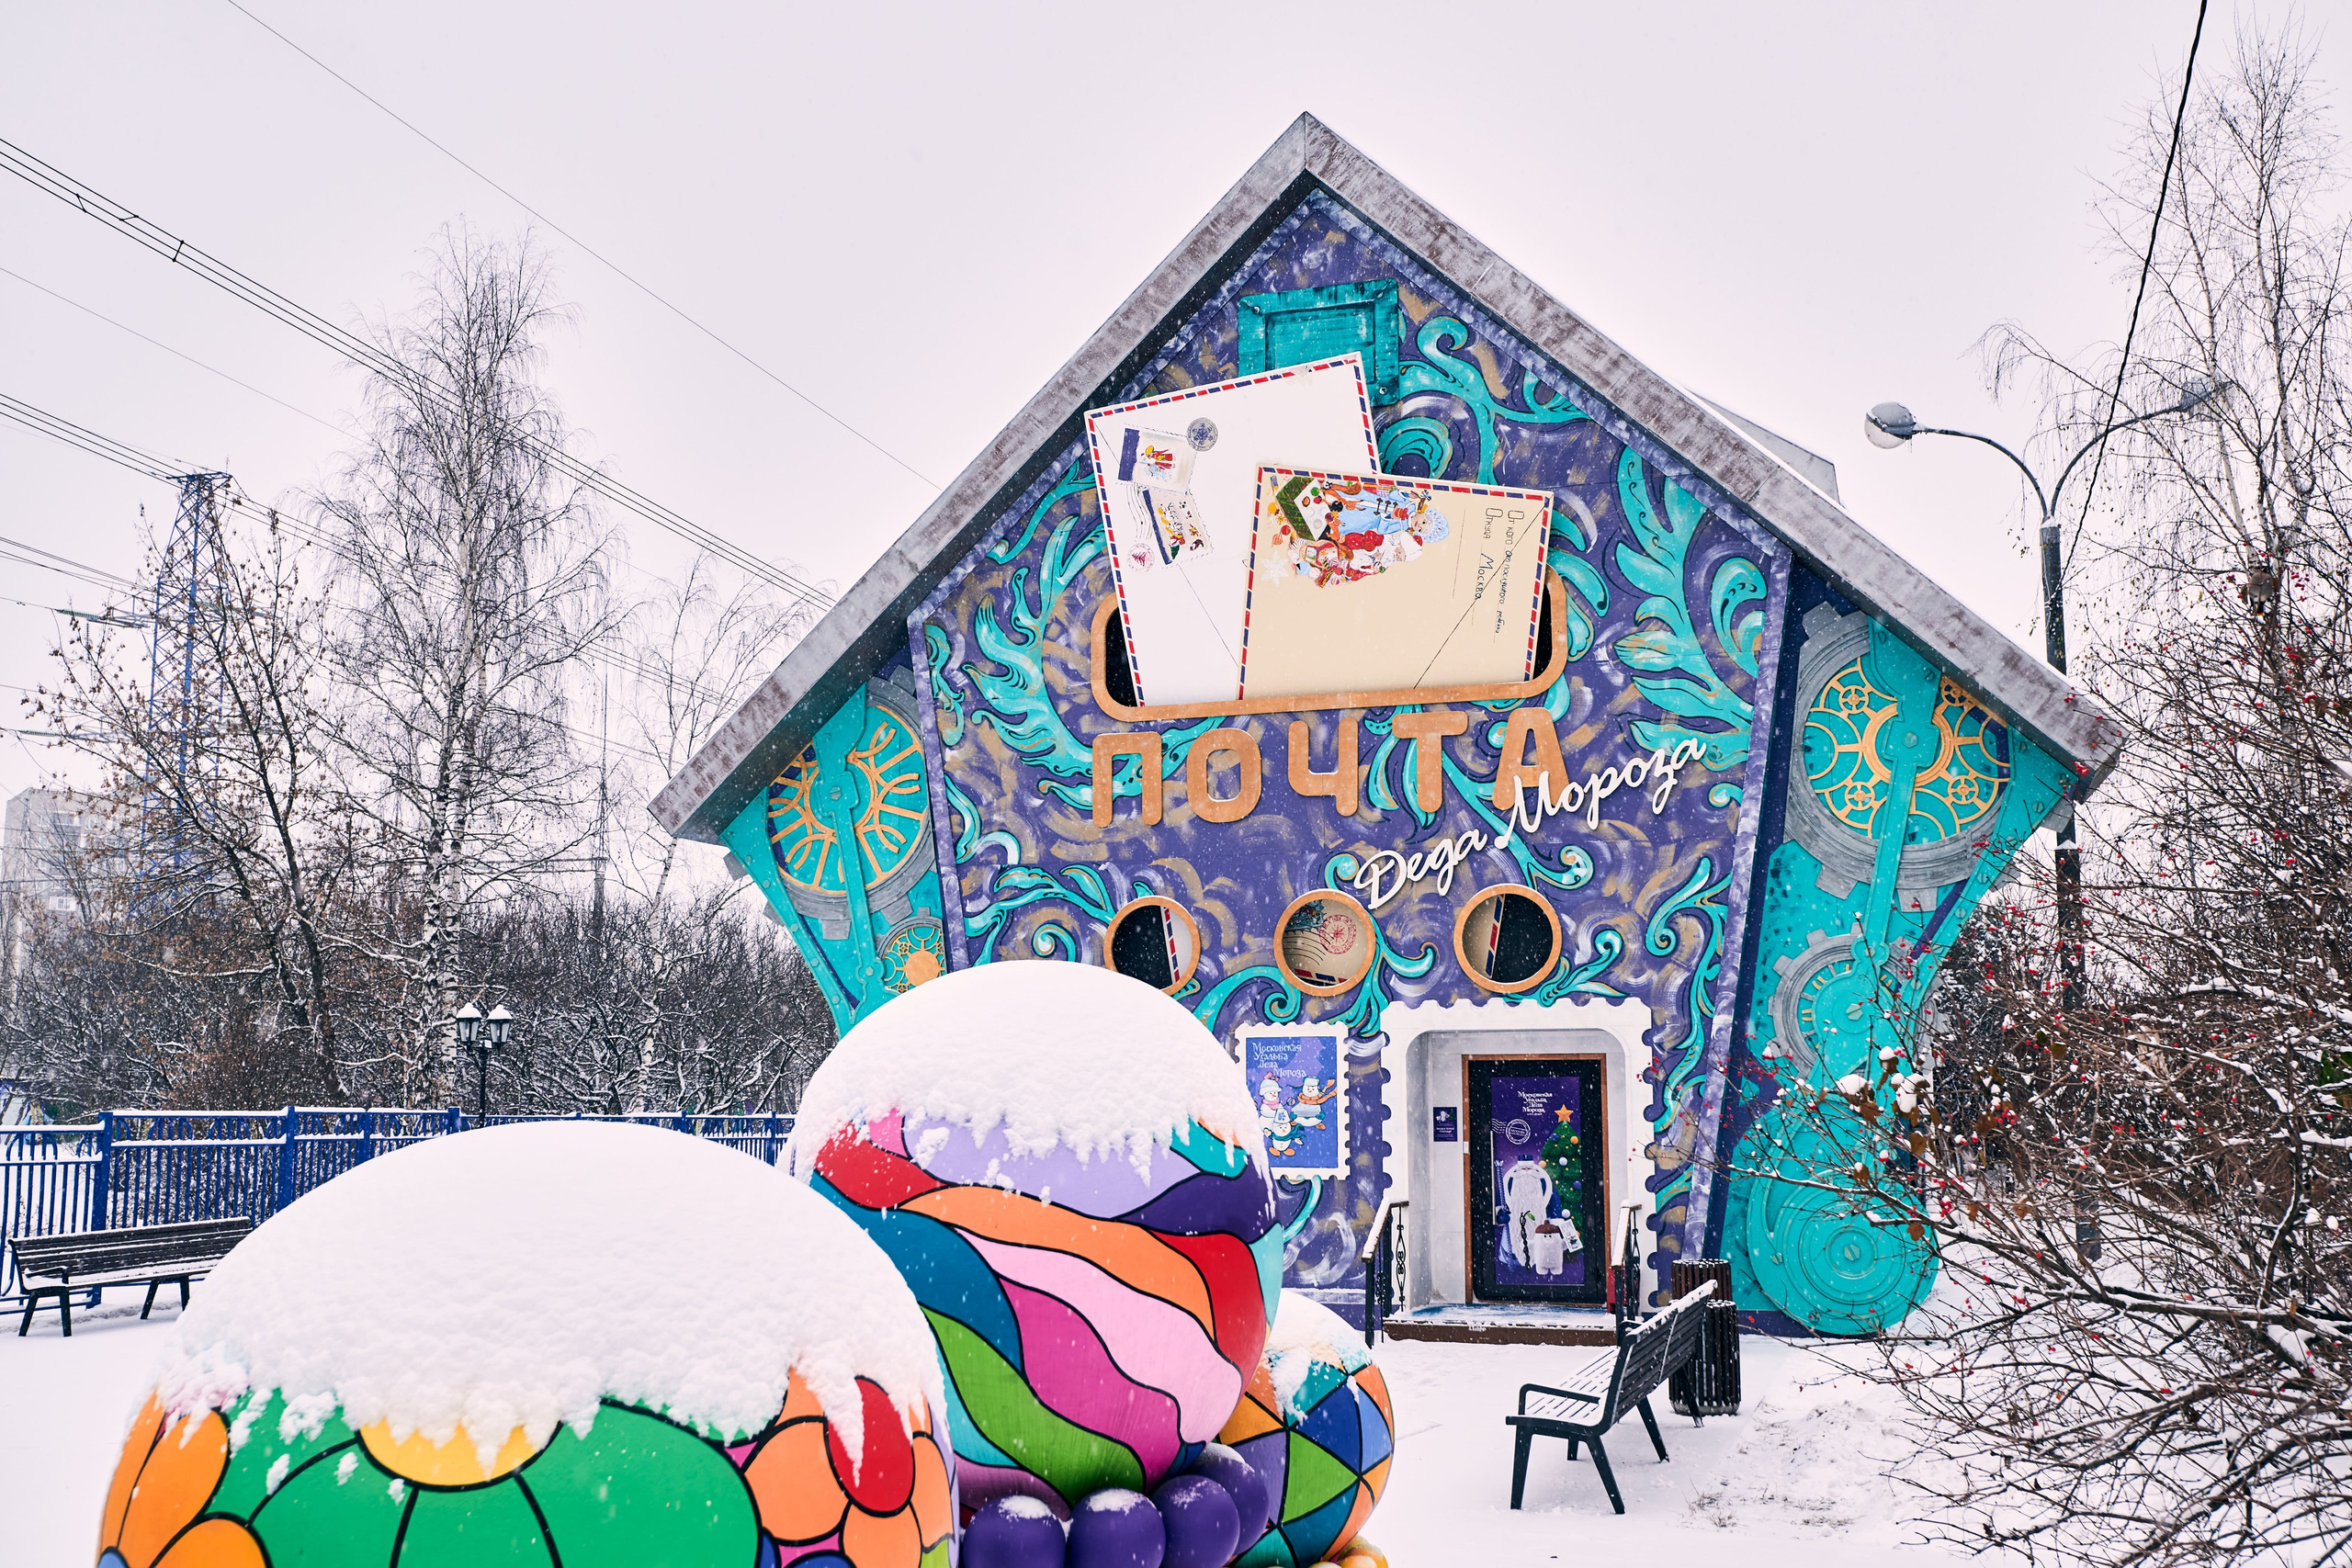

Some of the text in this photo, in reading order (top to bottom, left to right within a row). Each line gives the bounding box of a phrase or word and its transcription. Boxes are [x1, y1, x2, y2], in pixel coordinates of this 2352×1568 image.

[1508, 510, 1524, 525] От
[1475, 553, 1495, 600] Москва
[1092, 707, 1572, 828] ПОЧТА
[1353, 738, 1707, 910] Деда Мороза
[1252, 1042, 1302, 1053] Московская
[1272, 1067, 1306, 1078] Мороза
